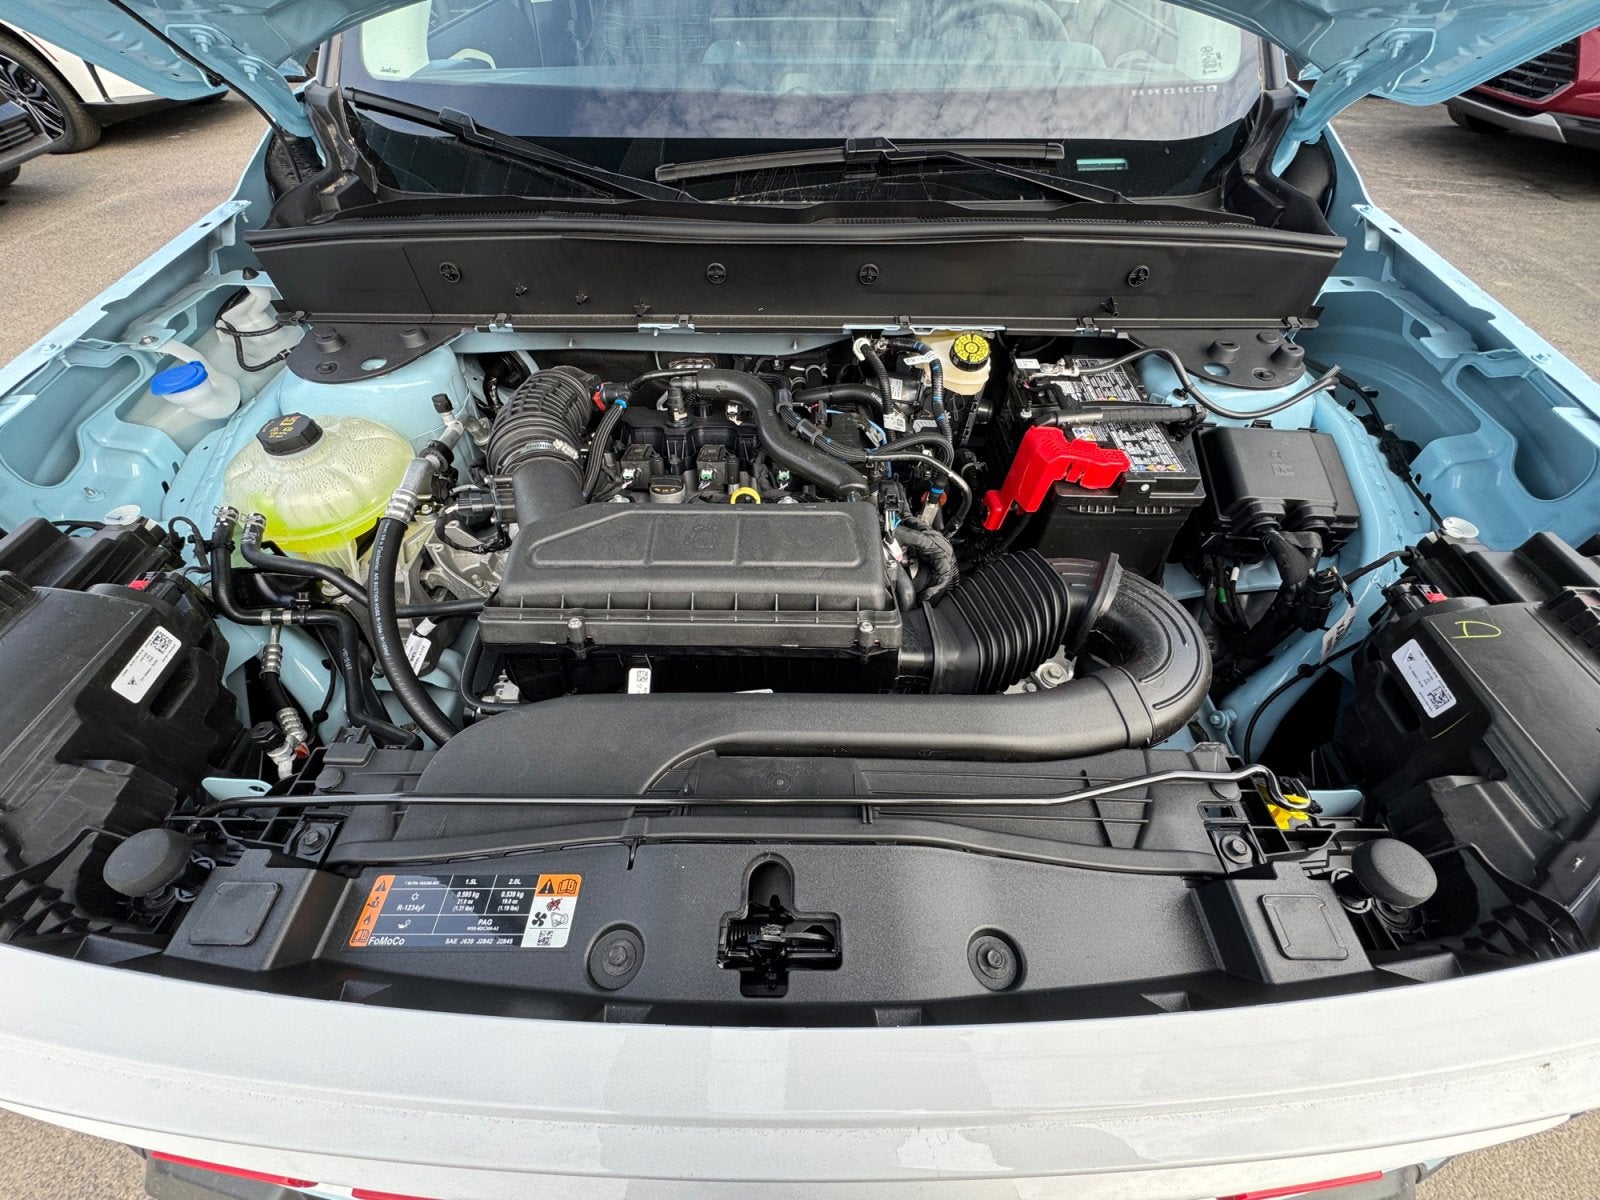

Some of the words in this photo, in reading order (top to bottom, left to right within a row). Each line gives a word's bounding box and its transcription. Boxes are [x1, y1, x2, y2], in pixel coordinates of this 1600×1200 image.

[472, 891, 480, 899] kg
[516, 891, 525, 899] kg
[396, 904, 426, 913] R-1234yf
[477, 918, 493, 926] PAG
[367, 936, 405, 946] FoMoCo
